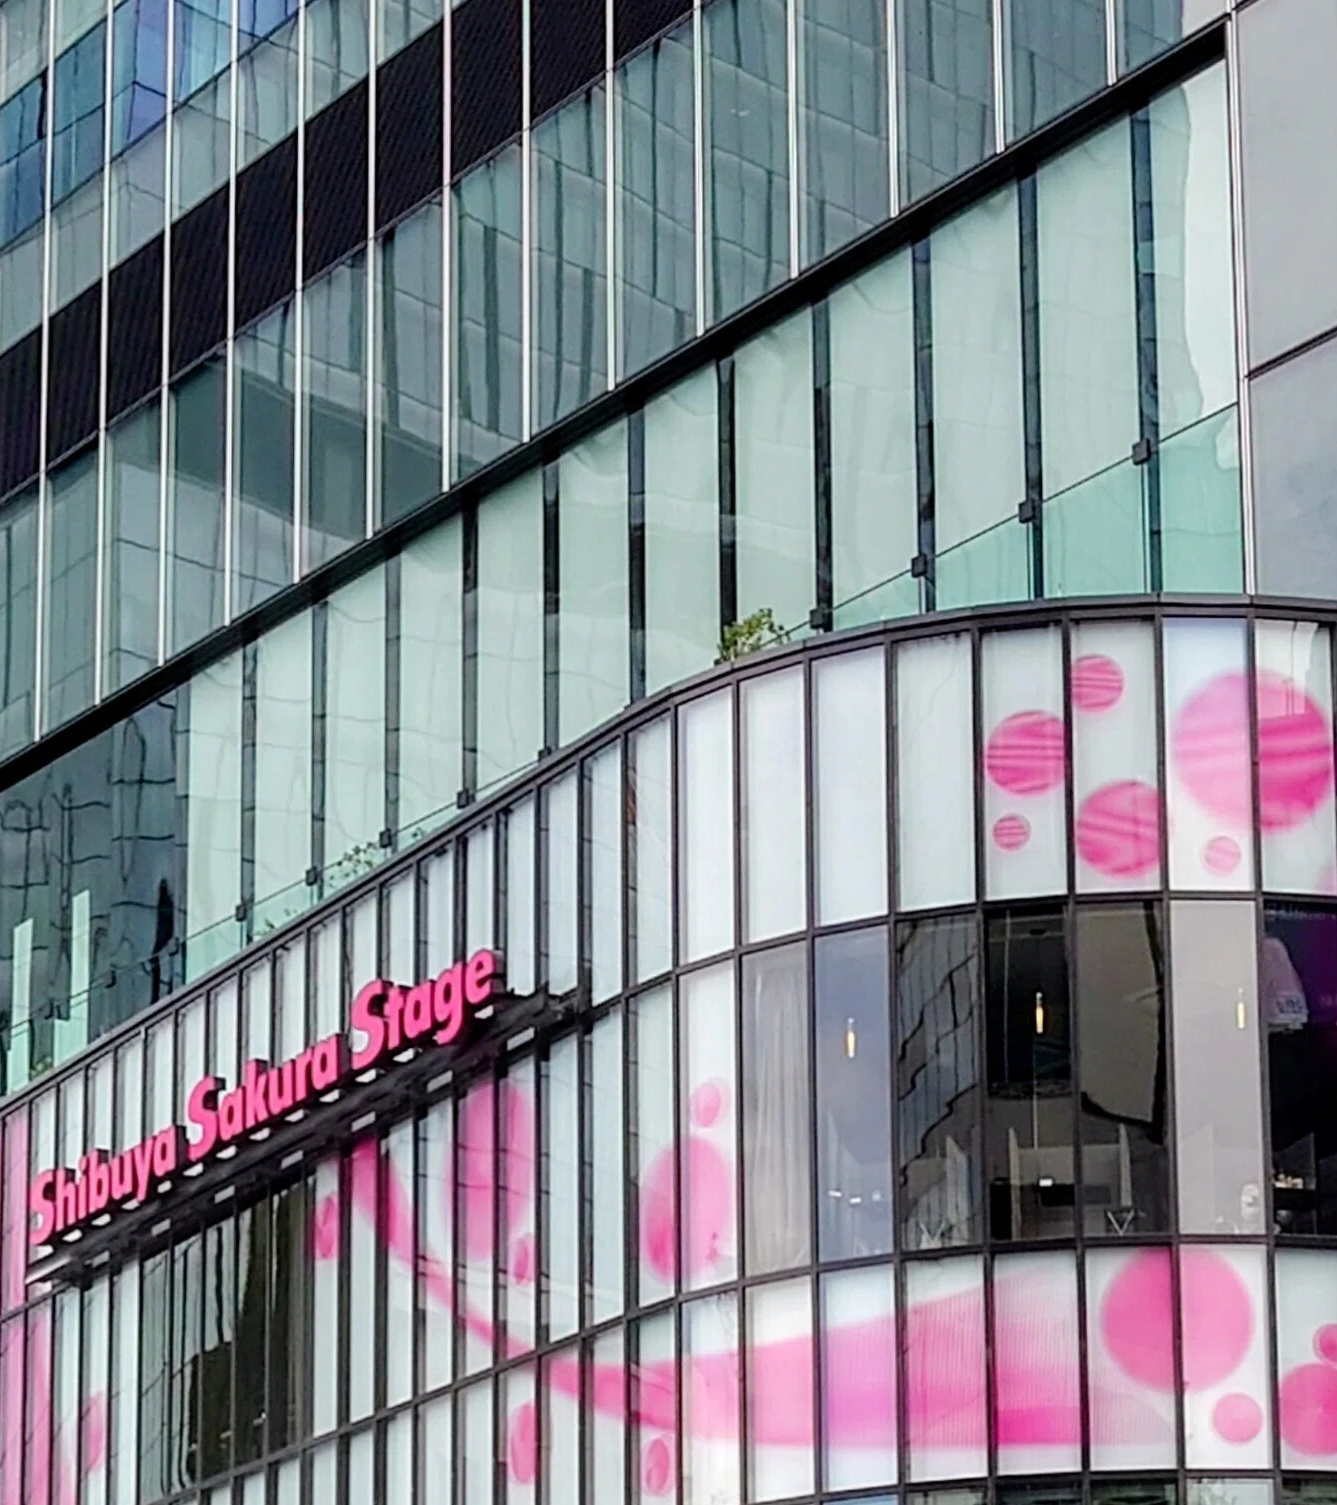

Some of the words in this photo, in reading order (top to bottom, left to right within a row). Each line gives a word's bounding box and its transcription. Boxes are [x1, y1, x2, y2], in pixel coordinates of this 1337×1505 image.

[29, 1127, 177, 1246] Shibuya
[187, 1034, 341, 1160] Sakura
[350, 949, 497, 1069] Stage
